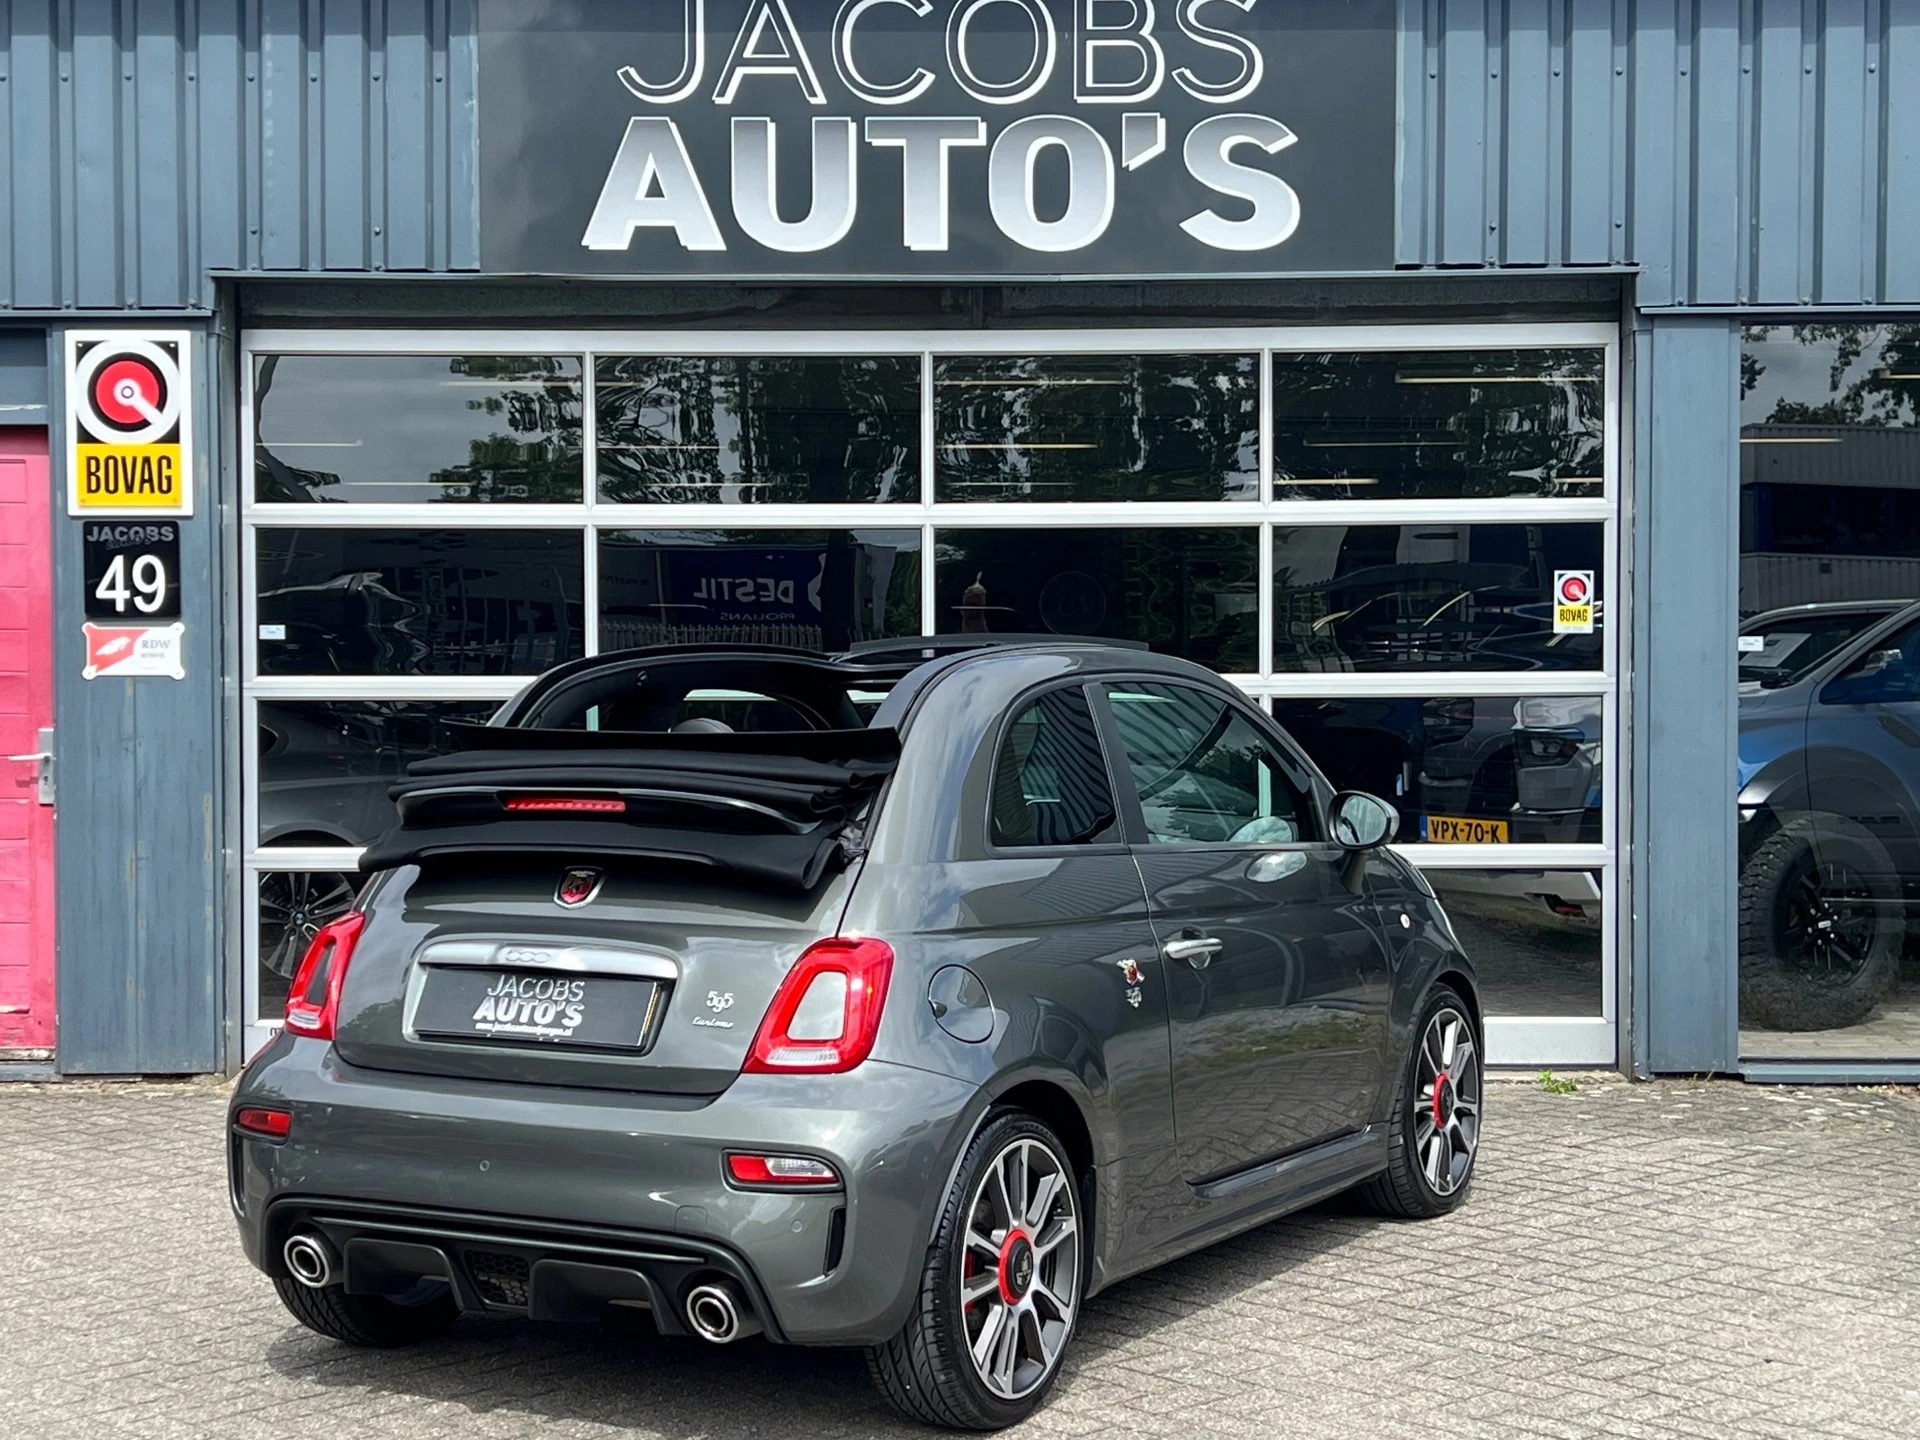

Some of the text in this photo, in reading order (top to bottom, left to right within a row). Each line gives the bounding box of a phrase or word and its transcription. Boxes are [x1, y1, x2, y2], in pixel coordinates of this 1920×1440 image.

[616, 0, 1265, 104] JACOBS
[581, 112, 1301, 252] AUTO'S
[85, 455, 173, 495] BOVAG
[86, 525, 175, 542] JACOBS
[95, 554, 166, 613] 49
[1559, 608, 1588, 622] BOVAG
[141, 639, 171, 649] RDW
[1430, 820, 1501, 843] VPX-70-K
[486, 974, 586, 1001] JACOBS
[472, 996, 586, 1027] AUTO'S
[706, 990, 734, 1013] 595
